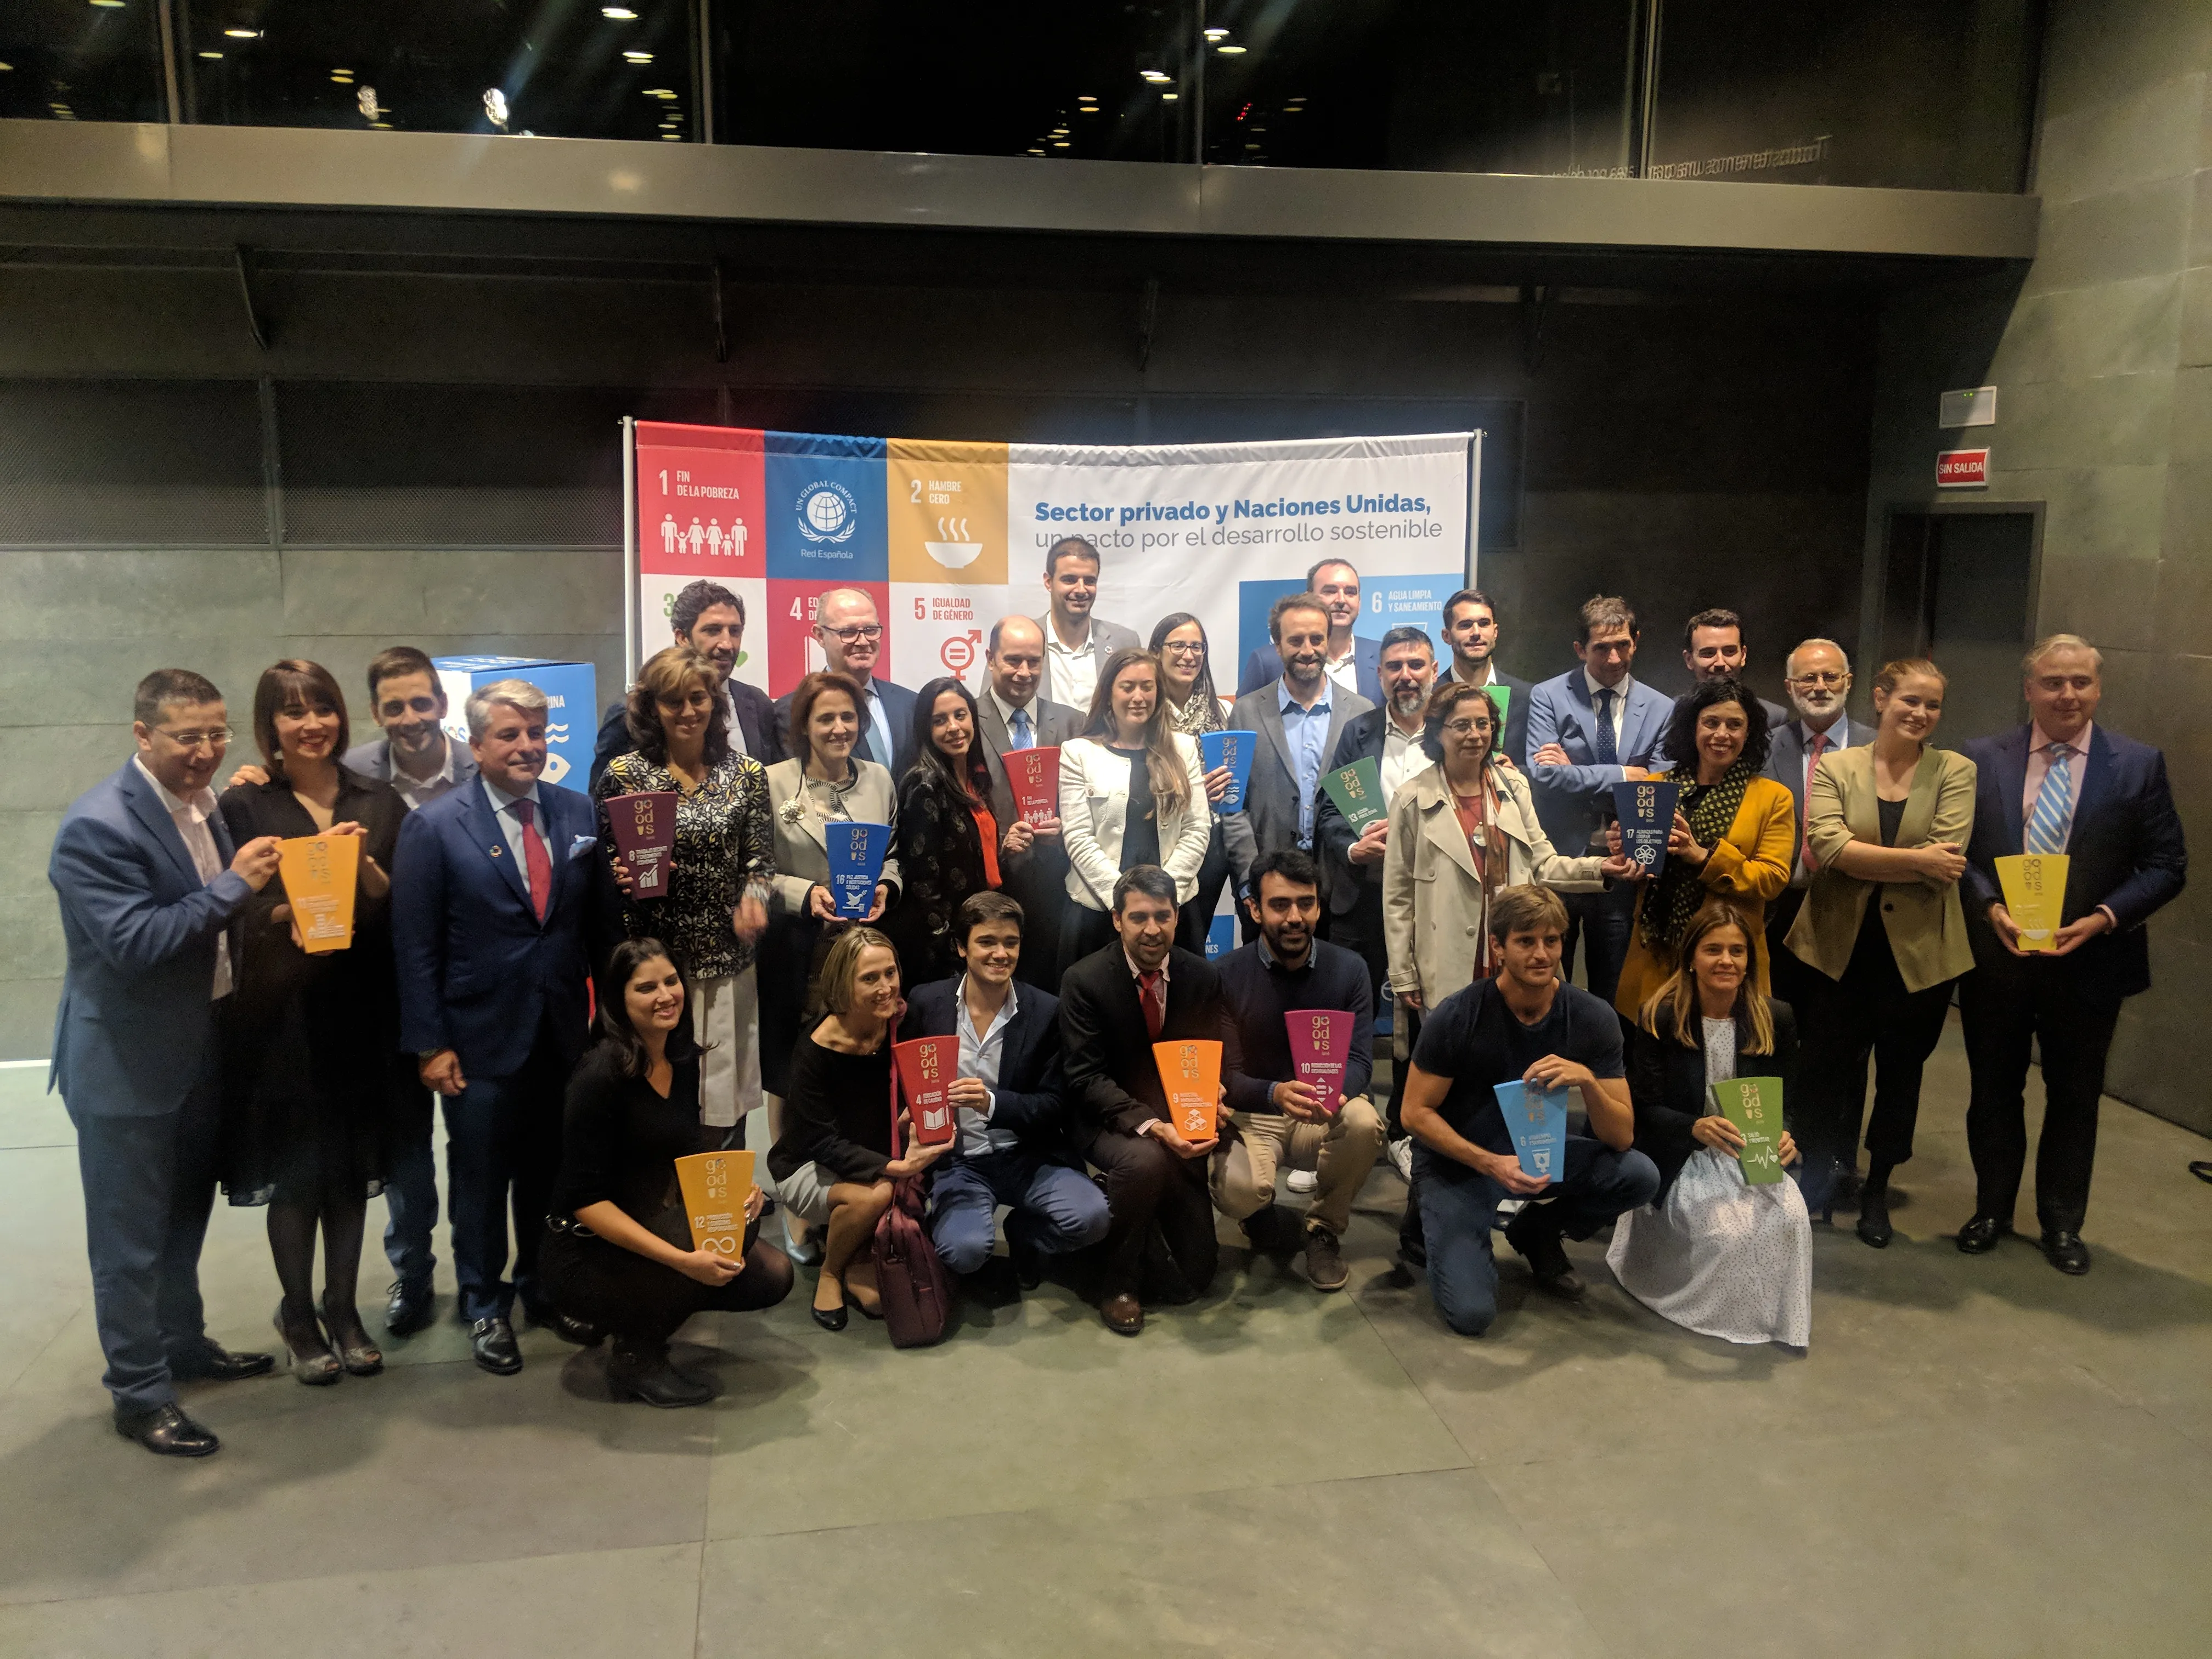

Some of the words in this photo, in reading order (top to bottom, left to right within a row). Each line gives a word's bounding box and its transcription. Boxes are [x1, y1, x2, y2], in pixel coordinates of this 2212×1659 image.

[1939, 463, 1953, 474] SIN
[1954, 461, 1983, 473] SALIDA
[659, 469, 668, 495] 1
[676, 470, 690, 483] FIN
[677, 484, 688, 496] DE
[689, 486, 700, 497] LA
[701, 486, 740, 500] POBREZA
[795, 498, 804, 511] UN
[800, 480, 830, 498] GLOBAL
[830, 481, 857, 514] COMPACT
[911, 479, 922, 504] 2
[929, 480, 962, 492] HAMBRE
[929, 493, 950, 504] CERO
[1035, 501, 1115, 522] Sector
[1120, 500, 1210, 527] privado
[1215, 504, 1229, 525] y
[1234, 497, 1341, 518] Naciones
[1346, 493, 1431, 516] Unidas,
[1142, 531, 1180, 552] por
[1186, 526, 1206, 546] el
[1211, 522, 1324, 545] desarrollo
[1329, 518, 1443, 540] sostenible
[800, 549, 816, 558] Red
[818, 549, 854, 560] Española
[663, 593, 674, 617] 3
[789, 596, 803, 620] 4
[1372, 591, 1382, 613] 6
[1389, 591, 1407, 600] AGUA
[1408, 590, 1432, 600] LIMPIA
[1388, 602, 1393, 612] Y
[1394, 601, 1442, 612] SANEAMIENTO
[914, 597, 925, 620] 5
[932, 597, 970, 608] IGUALDAD
[933, 610, 943, 620] DE
[944, 609, 973, 620] GÉNERO
[1022, 796, 1026, 805] 1
[1626, 828, 1635, 839] 17
[629, 850, 635, 861] 8
[836, 874, 845, 884] 16
[1301, 1063, 1310, 1074] 10
[916, 1094, 922, 1105] 4
[695, 1216, 705, 1229] 12
